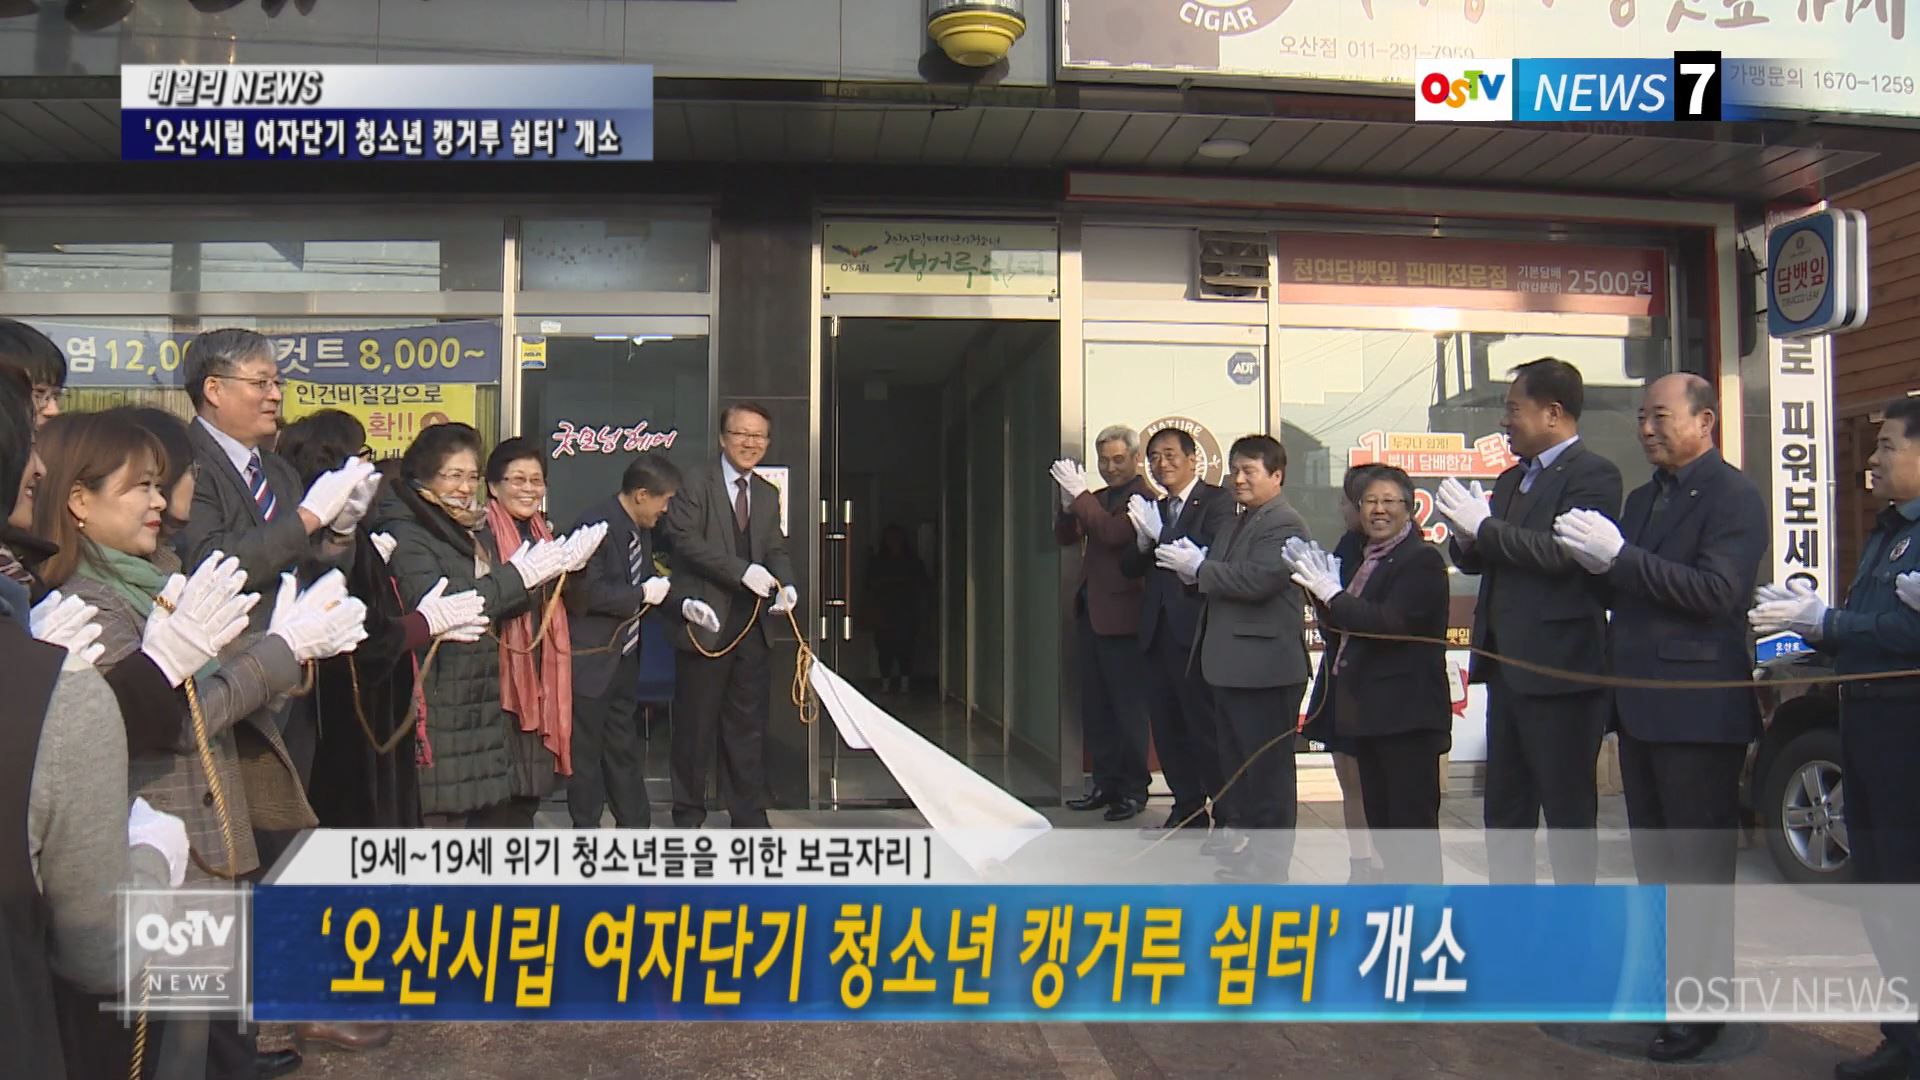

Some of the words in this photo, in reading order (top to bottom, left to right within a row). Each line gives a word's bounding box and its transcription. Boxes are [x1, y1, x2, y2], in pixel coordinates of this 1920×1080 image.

[1178, 2, 1259, 32] CIGAR
[1279, 35, 1338, 60] 오산점
[1729, 64, 1805, 90] 가맹문의
[1814, 70, 1915, 95] 1670-1259
[840, 263, 870, 273] OSAN
[1406, 262, 1508, 289] 판매전문점
[1777, 257, 1825, 295] 담뱃잎
[1567, 269, 1652, 297] 2500원
[67, 336, 97, 373] 염
[105, 339, 192, 375] 12,0
[277, 337, 350, 374] 컷트
[359, 335, 485, 377] 8,000~
[1232, 362, 1256, 375] ADT
[296, 384, 444, 406] 인건비절감으로
[1419, 454, 1473, 473] 담배한갑
